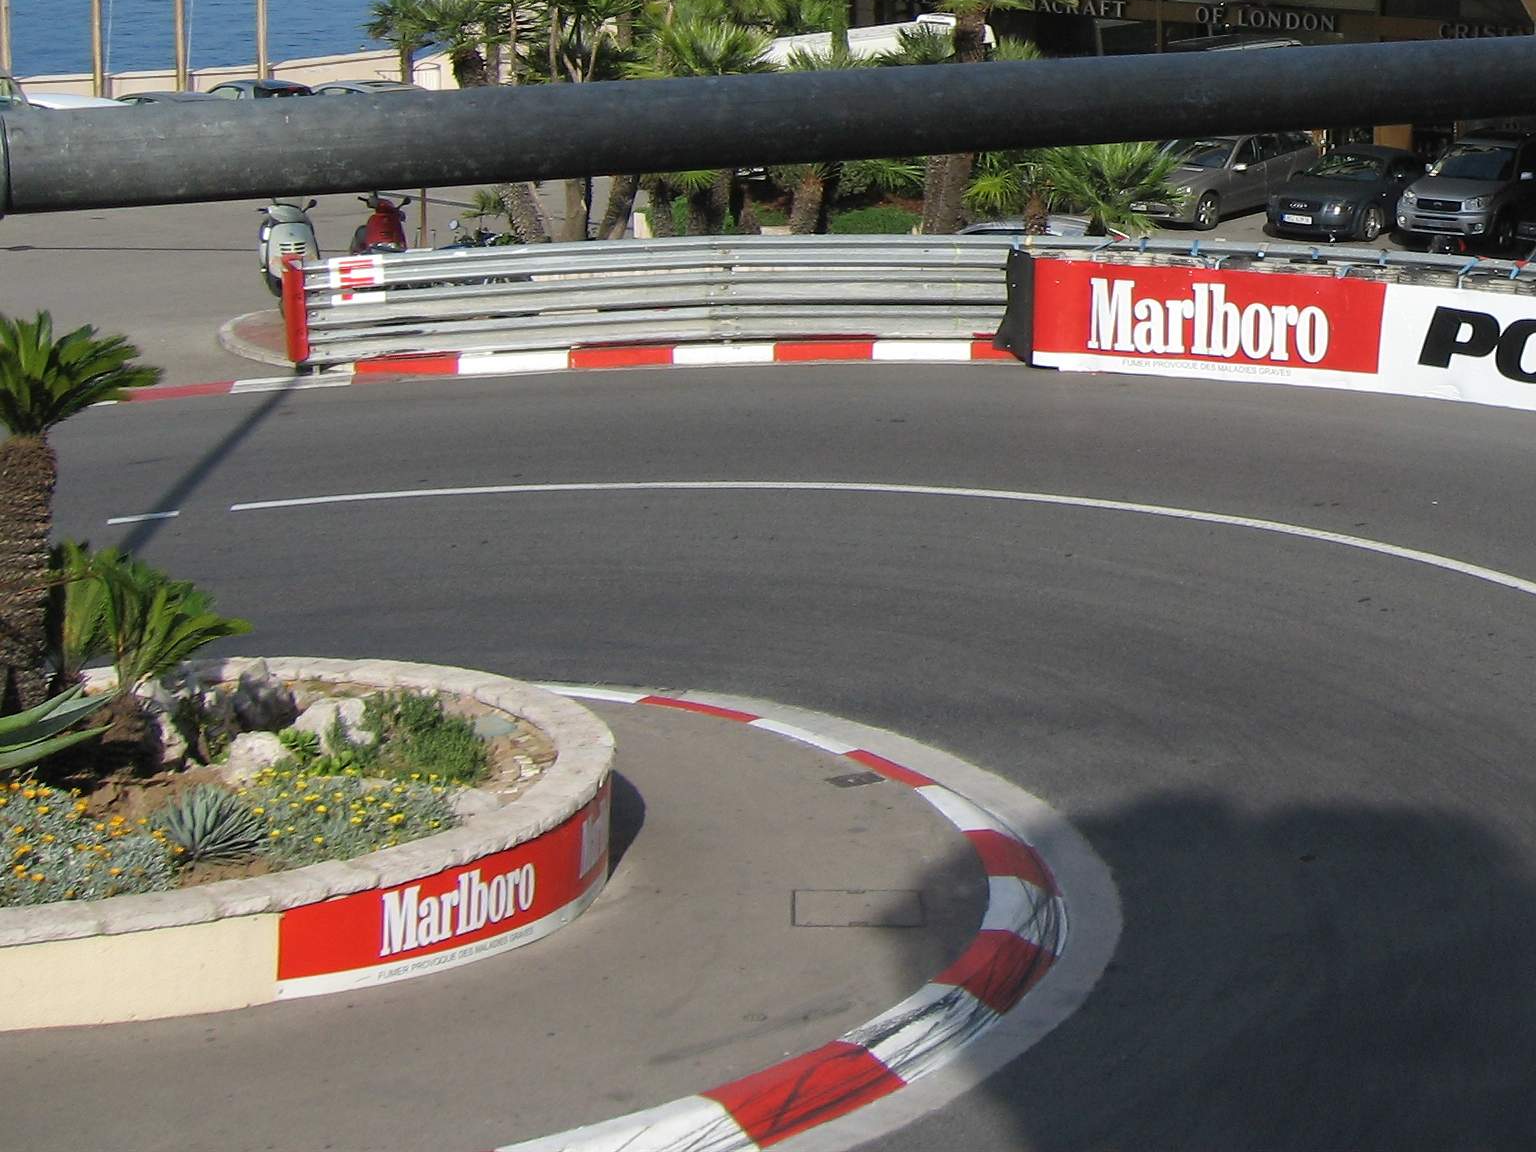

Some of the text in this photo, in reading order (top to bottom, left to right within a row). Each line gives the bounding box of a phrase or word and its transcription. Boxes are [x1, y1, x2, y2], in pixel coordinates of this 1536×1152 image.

[1195, 6, 1223, 24] OF
[1238, 9, 1335, 32] LONDON
[1087, 277, 1330, 364] Marlboro
[1122, 359, 1291, 377] FUMER PROVOQUE DES MALADIES GRAVES
[379, 863, 535, 957] Marlboro
